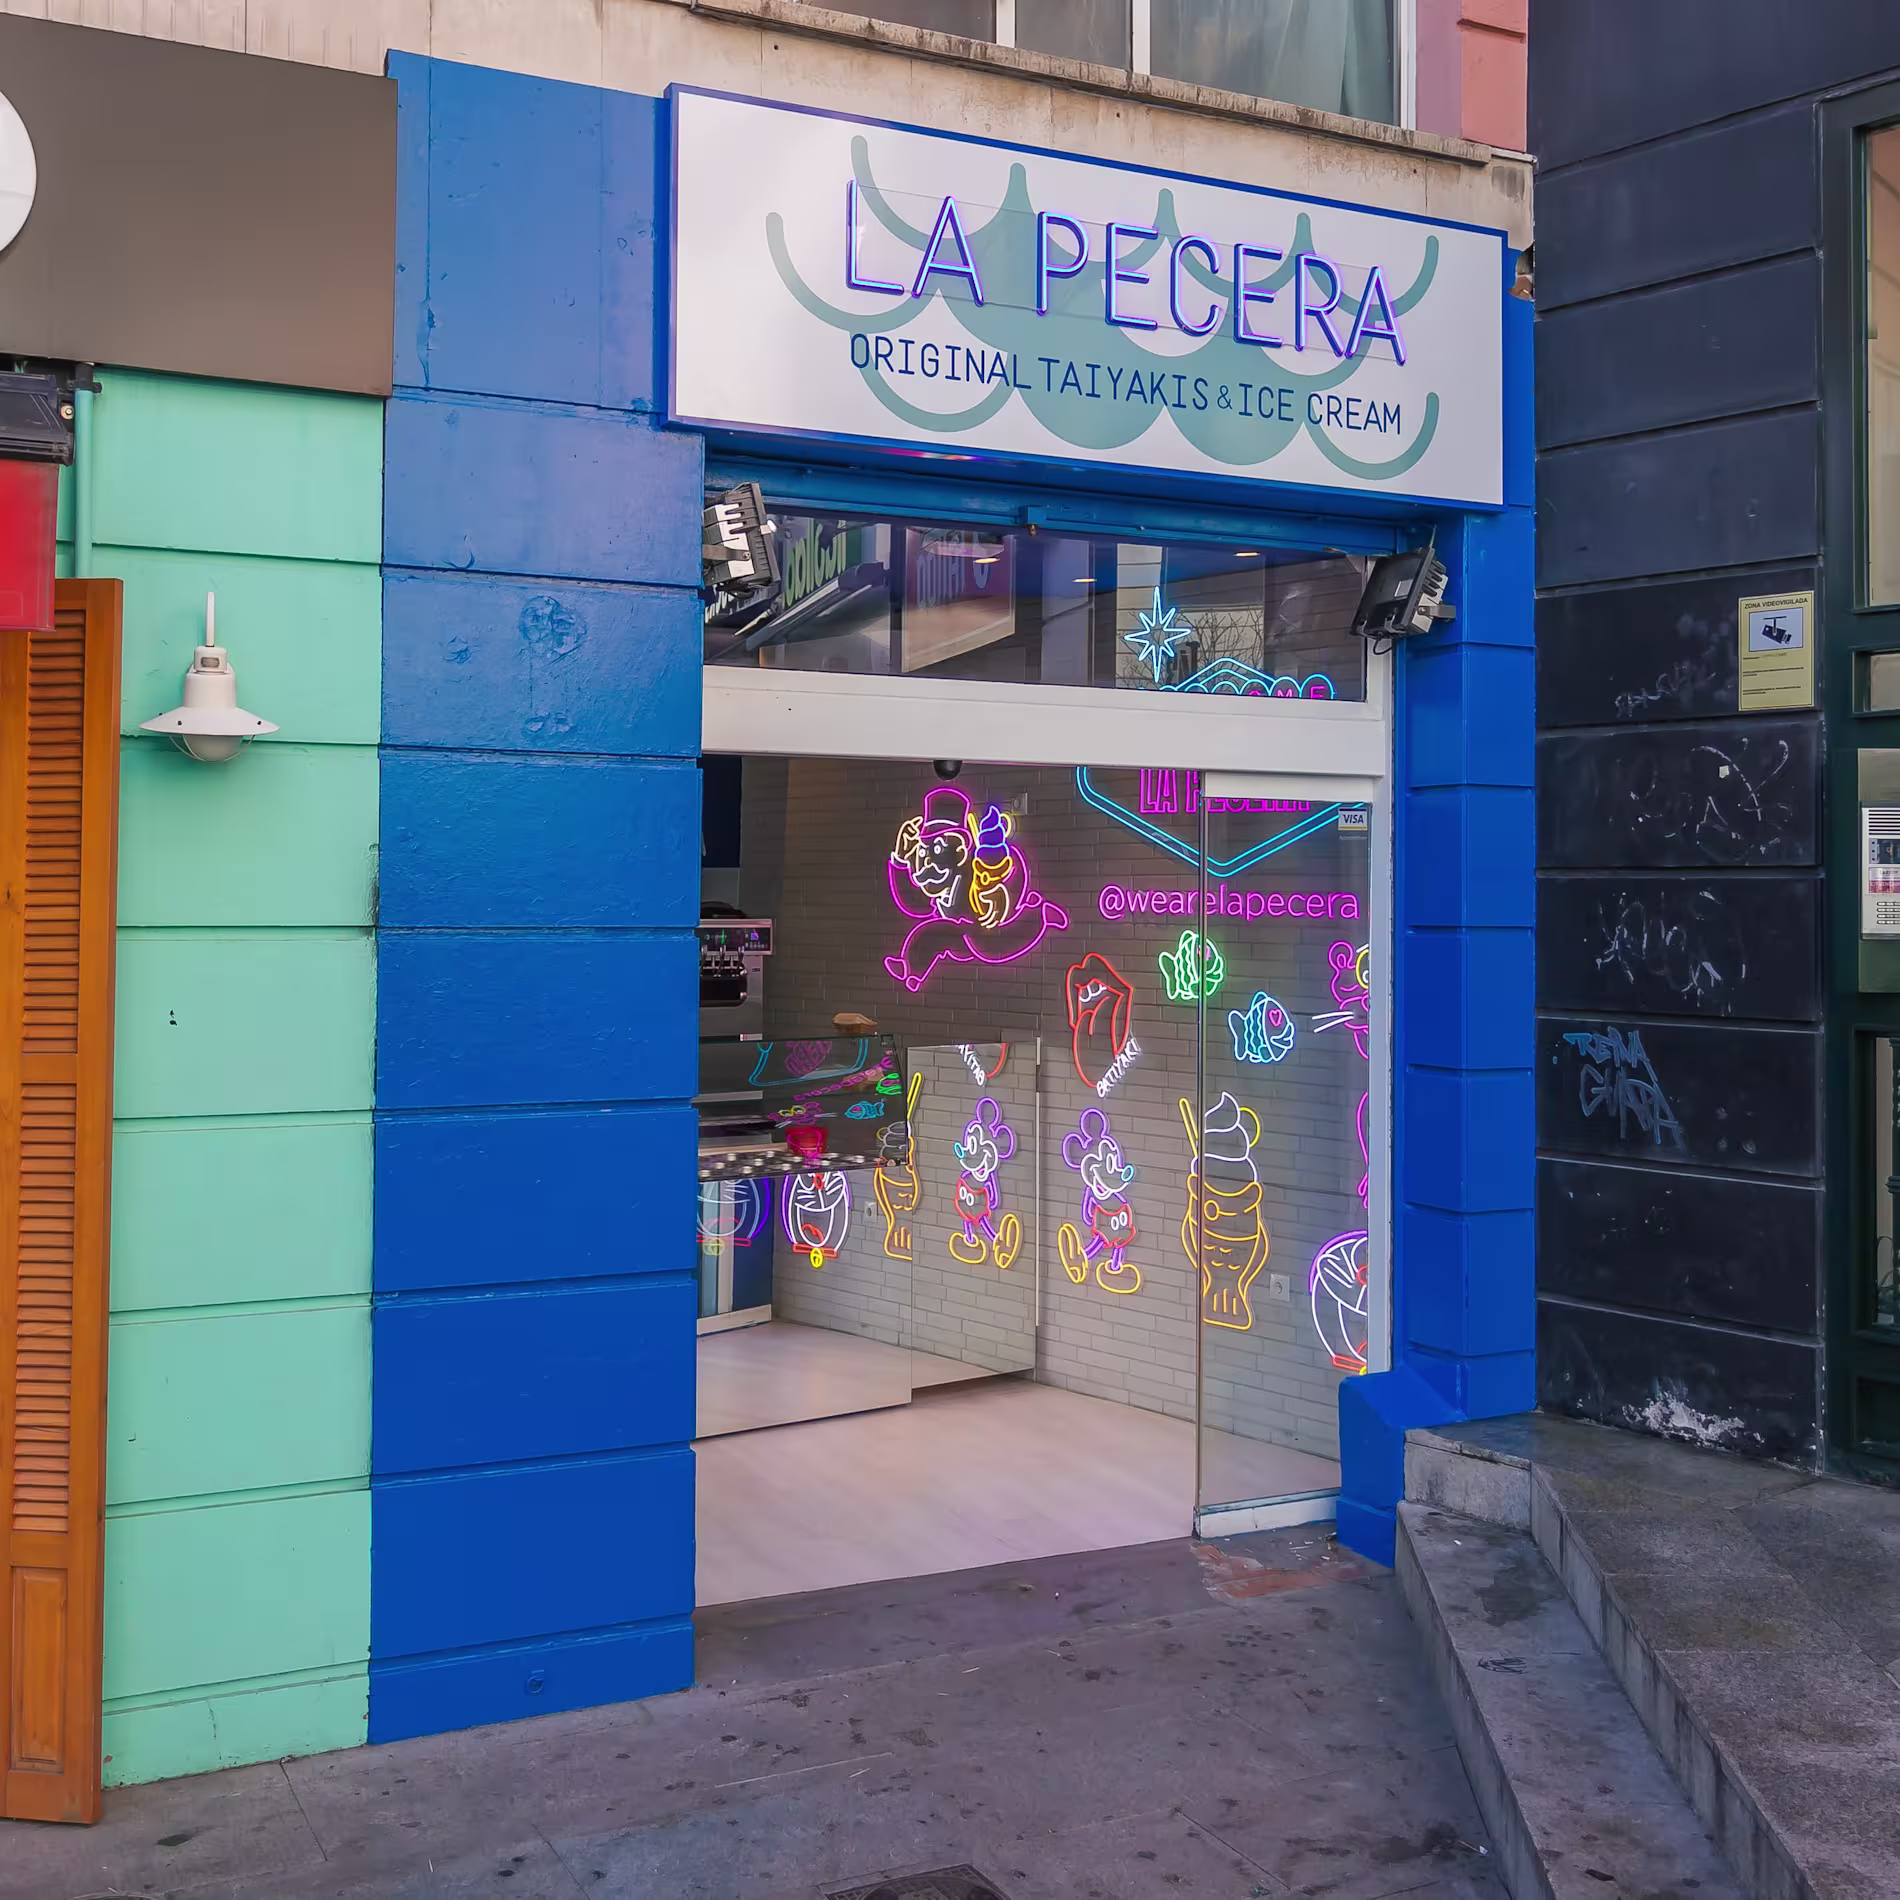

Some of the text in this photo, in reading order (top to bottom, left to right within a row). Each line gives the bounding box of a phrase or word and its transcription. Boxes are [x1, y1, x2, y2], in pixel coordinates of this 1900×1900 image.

[846, 178, 1406, 367] LA PECERA
[850, 333, 1401, 436] ORIGINAL TAIYAKIS & ICE CREAM
[1744, 597, 1809, 610] ZONA VIDEOVIGILADA
[1342, 814, 1364, 824] VISA
[1098, 883, 1360, 922] @wearelapecera
